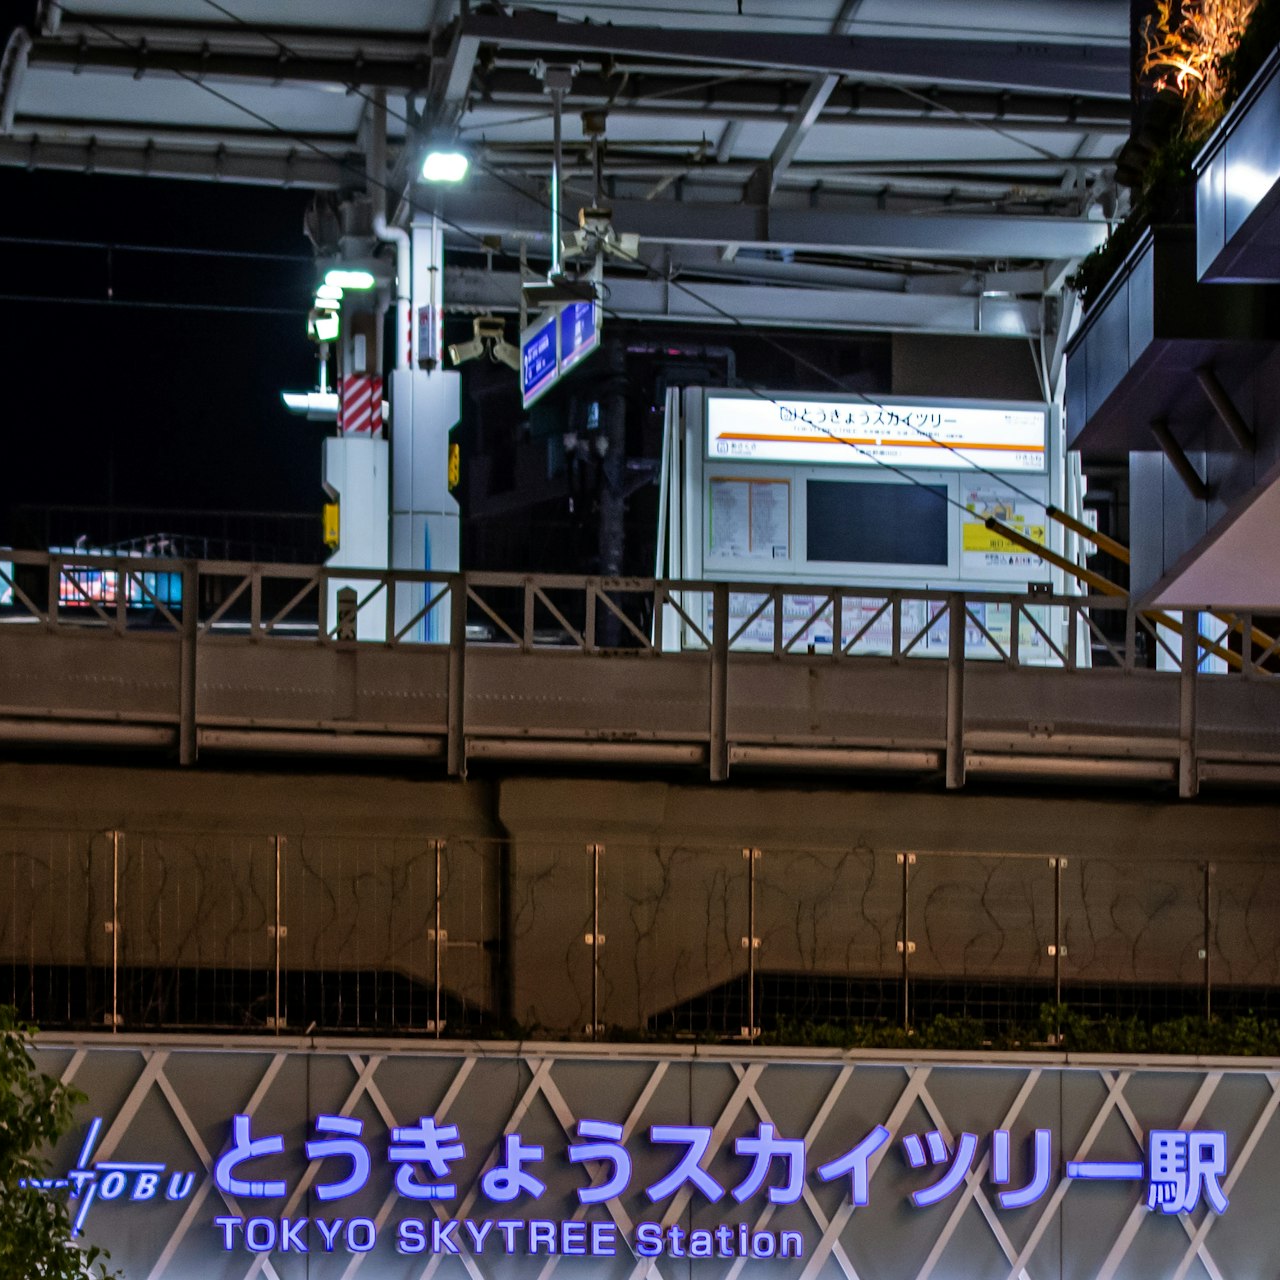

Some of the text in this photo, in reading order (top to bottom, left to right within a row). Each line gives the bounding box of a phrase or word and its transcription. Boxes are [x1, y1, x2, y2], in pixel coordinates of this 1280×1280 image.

[800, 408, 957, 427] とうきょうスカイツリー
[216, 1114, 1228, 1214] とうきょうスカイツリー駅
[216, 1217, 804, 1258] TOKYO SKYTREE Station
